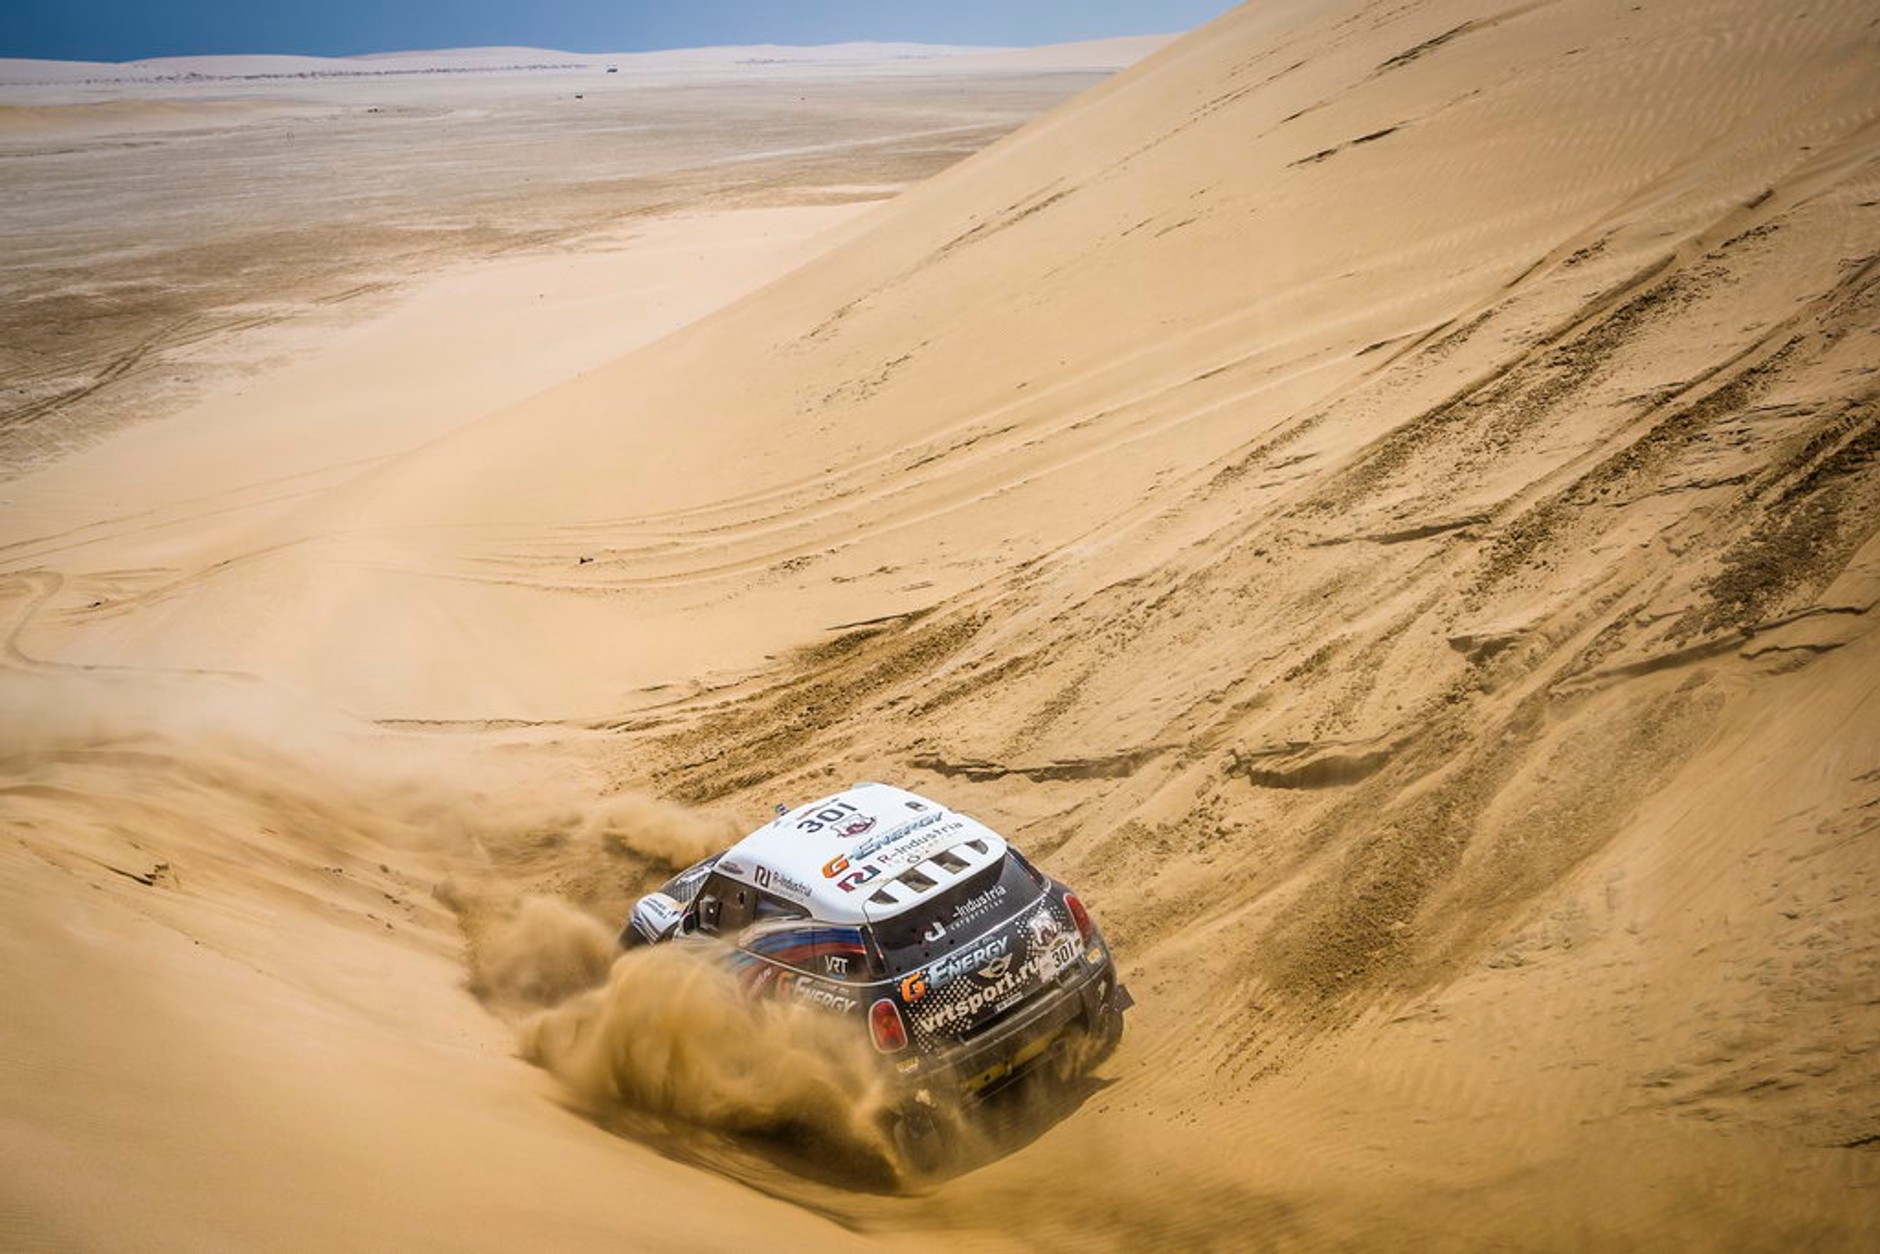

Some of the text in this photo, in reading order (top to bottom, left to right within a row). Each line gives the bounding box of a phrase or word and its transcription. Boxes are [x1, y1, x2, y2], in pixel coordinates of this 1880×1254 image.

[797, 802, 858, 833] 301
[877, 821, 964, 864] R-Industria
[824, 955, 849, 974] VRT
[1052, 941, 1075, 968] 301
[918, 957, 1041, 1033] vrtsport.ru
